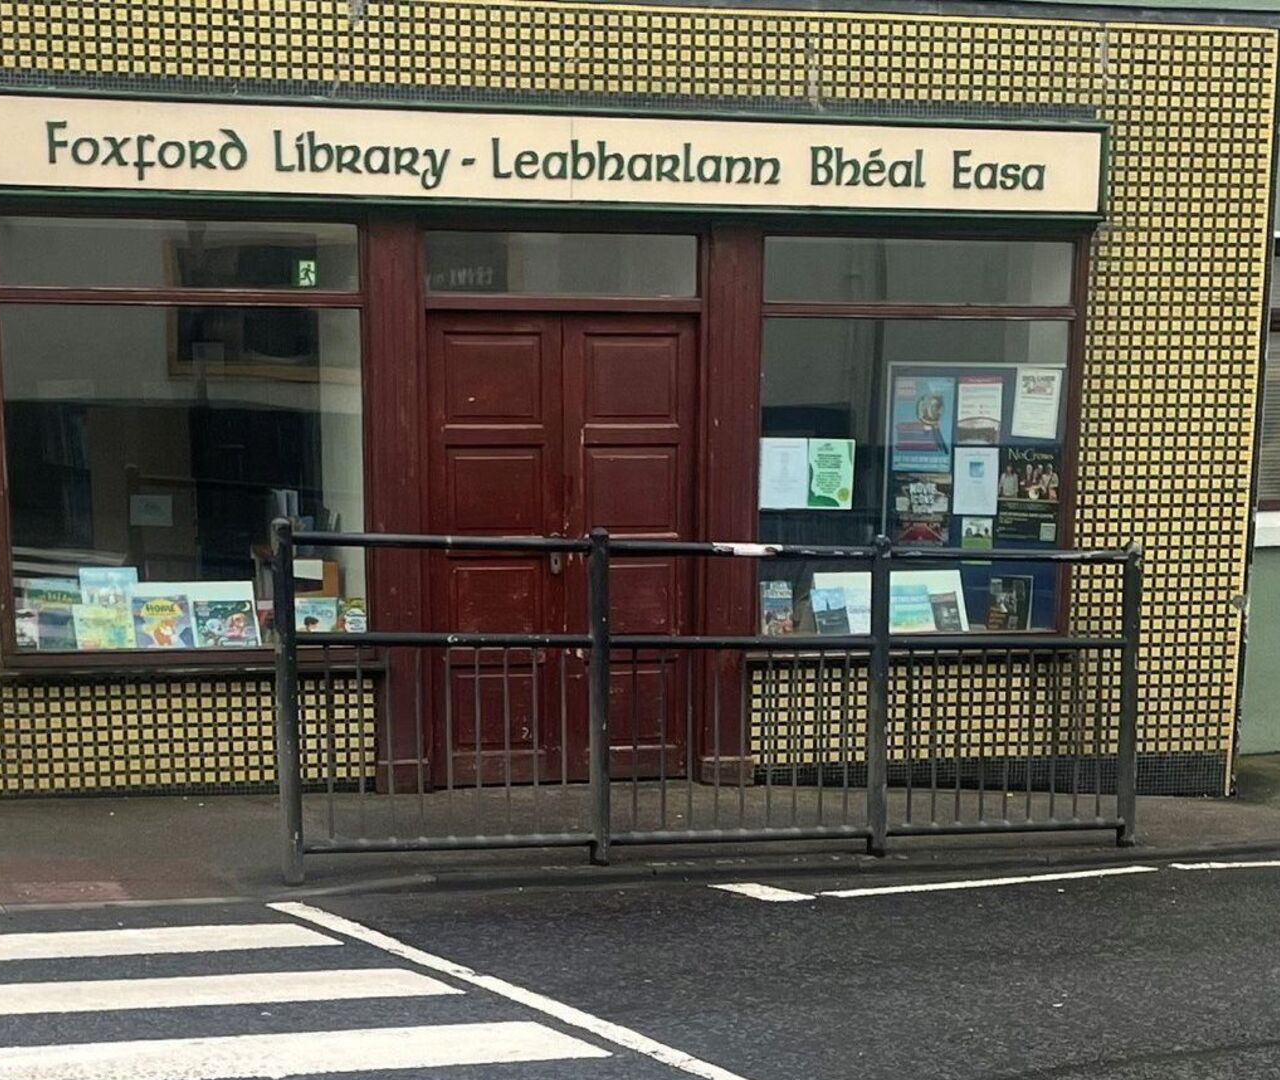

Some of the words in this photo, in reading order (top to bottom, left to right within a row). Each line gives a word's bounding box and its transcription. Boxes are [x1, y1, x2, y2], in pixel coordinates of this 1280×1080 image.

[46, 120, 248, 182] Foxford
[273, 129, 451, 191] Library
[491, 137, 781, 186] Leabharlann
[810, 145, 926, 188] Bhéal
[952, 149, 1046, 191] Easa
